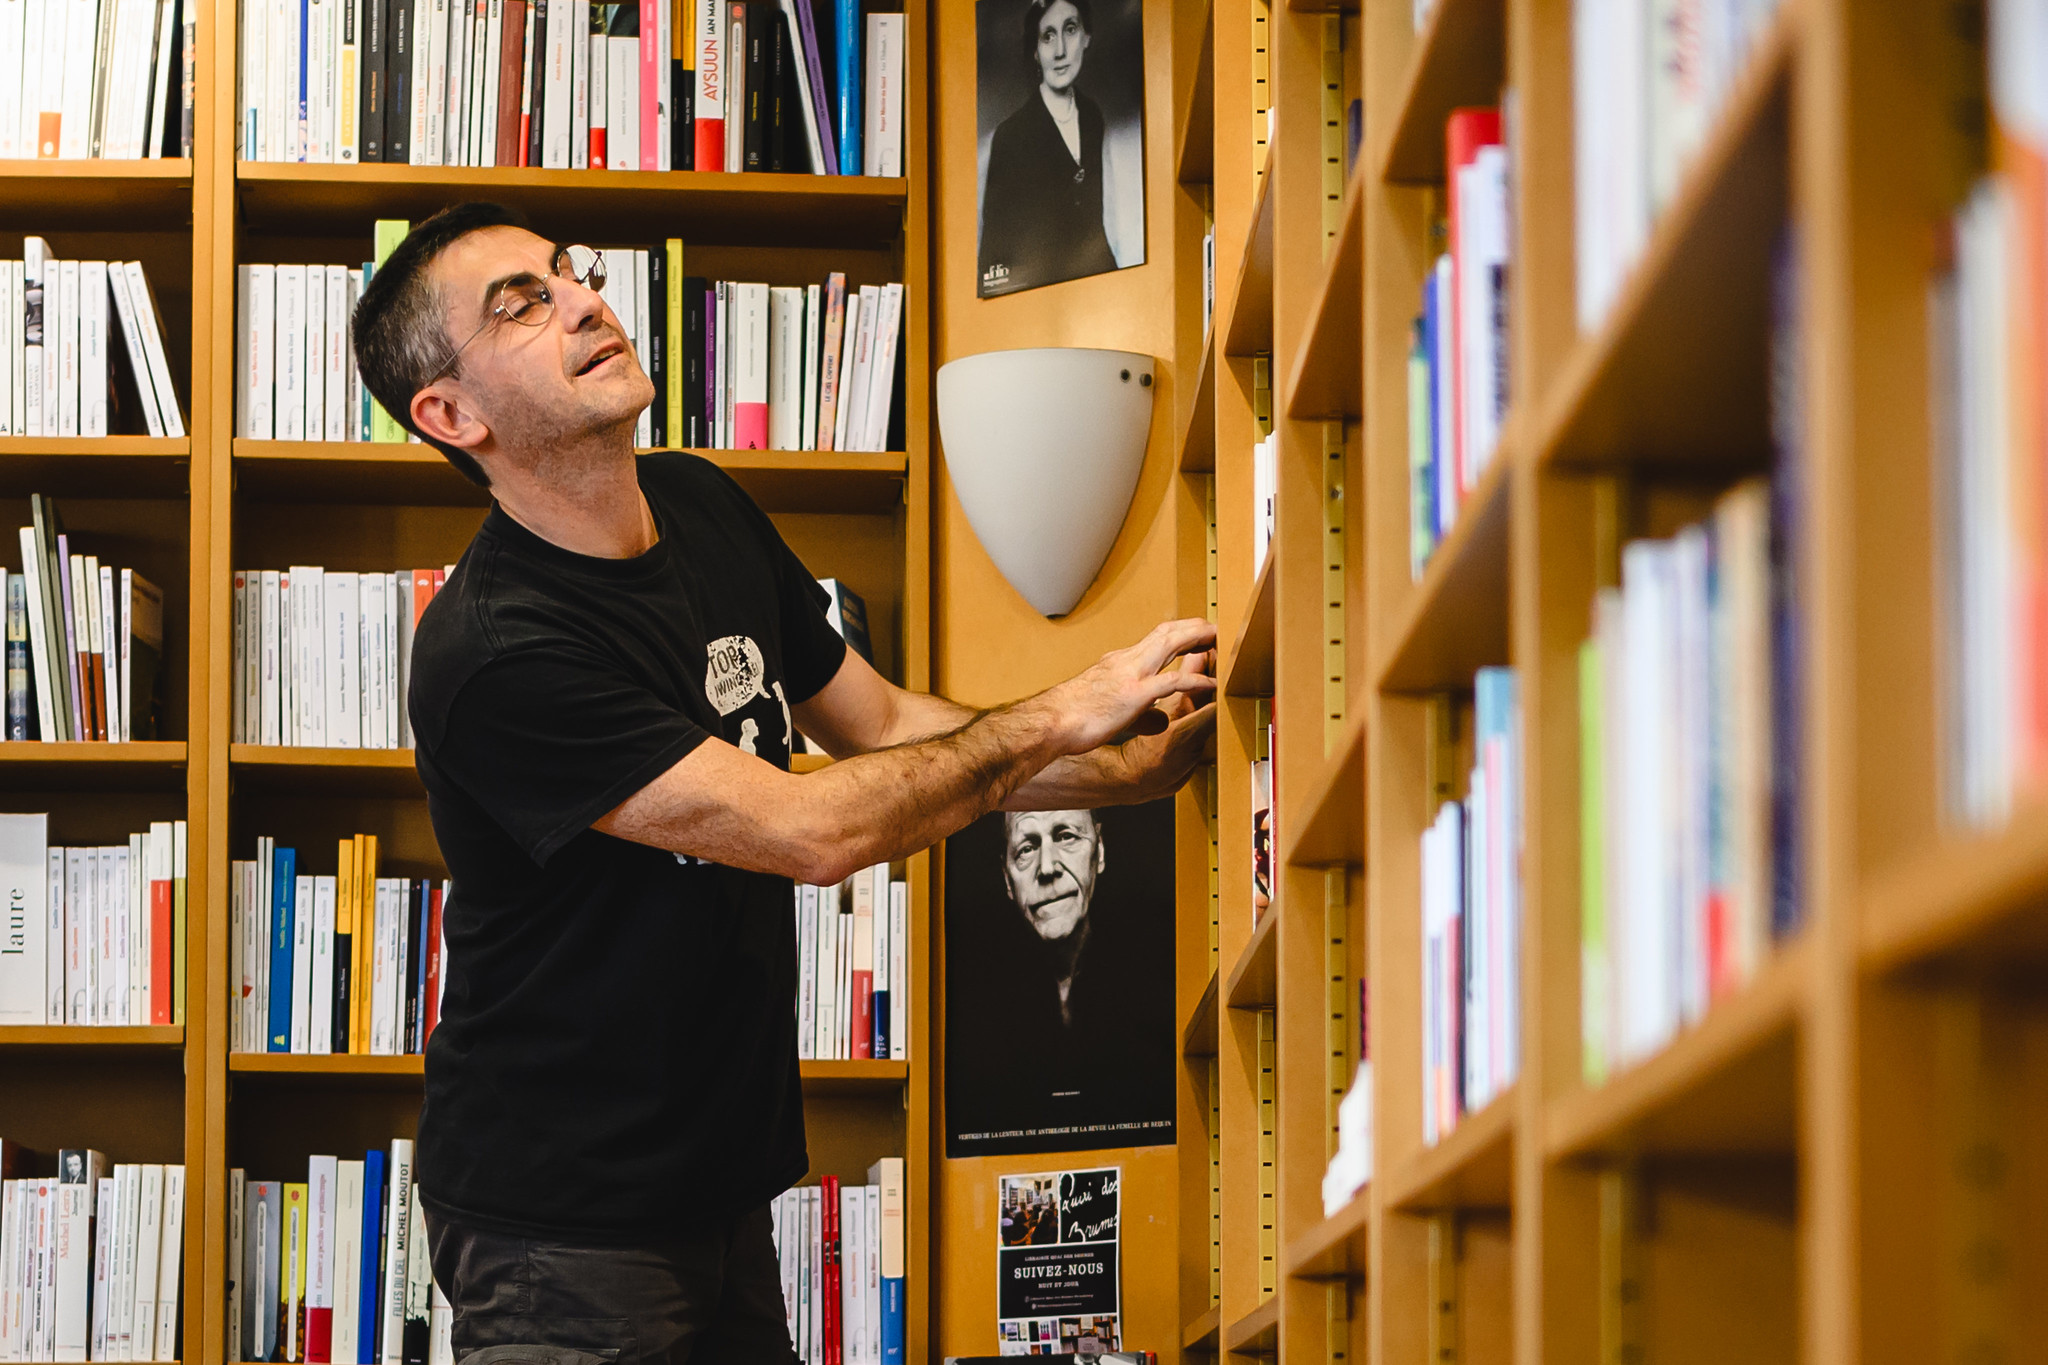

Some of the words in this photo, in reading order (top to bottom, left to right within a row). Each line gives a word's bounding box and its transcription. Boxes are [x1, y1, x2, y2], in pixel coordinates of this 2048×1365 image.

[707, 19, 715, 35] IAN
[703, 39, 718, 101] AYSUUN
[1, 888, 25, 956] laure
[398, 1164, 409, 1208] MOUTOT
[60, 1189, 70, 1219] Leiris
[60, 1222, 70, 1260] Michel
[396, 1210, 407, 1251] MICHEL
[394, 1258, 405, 1277] CIEL
[1014, 1262, 1104, 1279] SUIVEZ-NOUS
[394, 1277, 404, 1289] DU
[392, 1290, 404, 1318] FILLES
